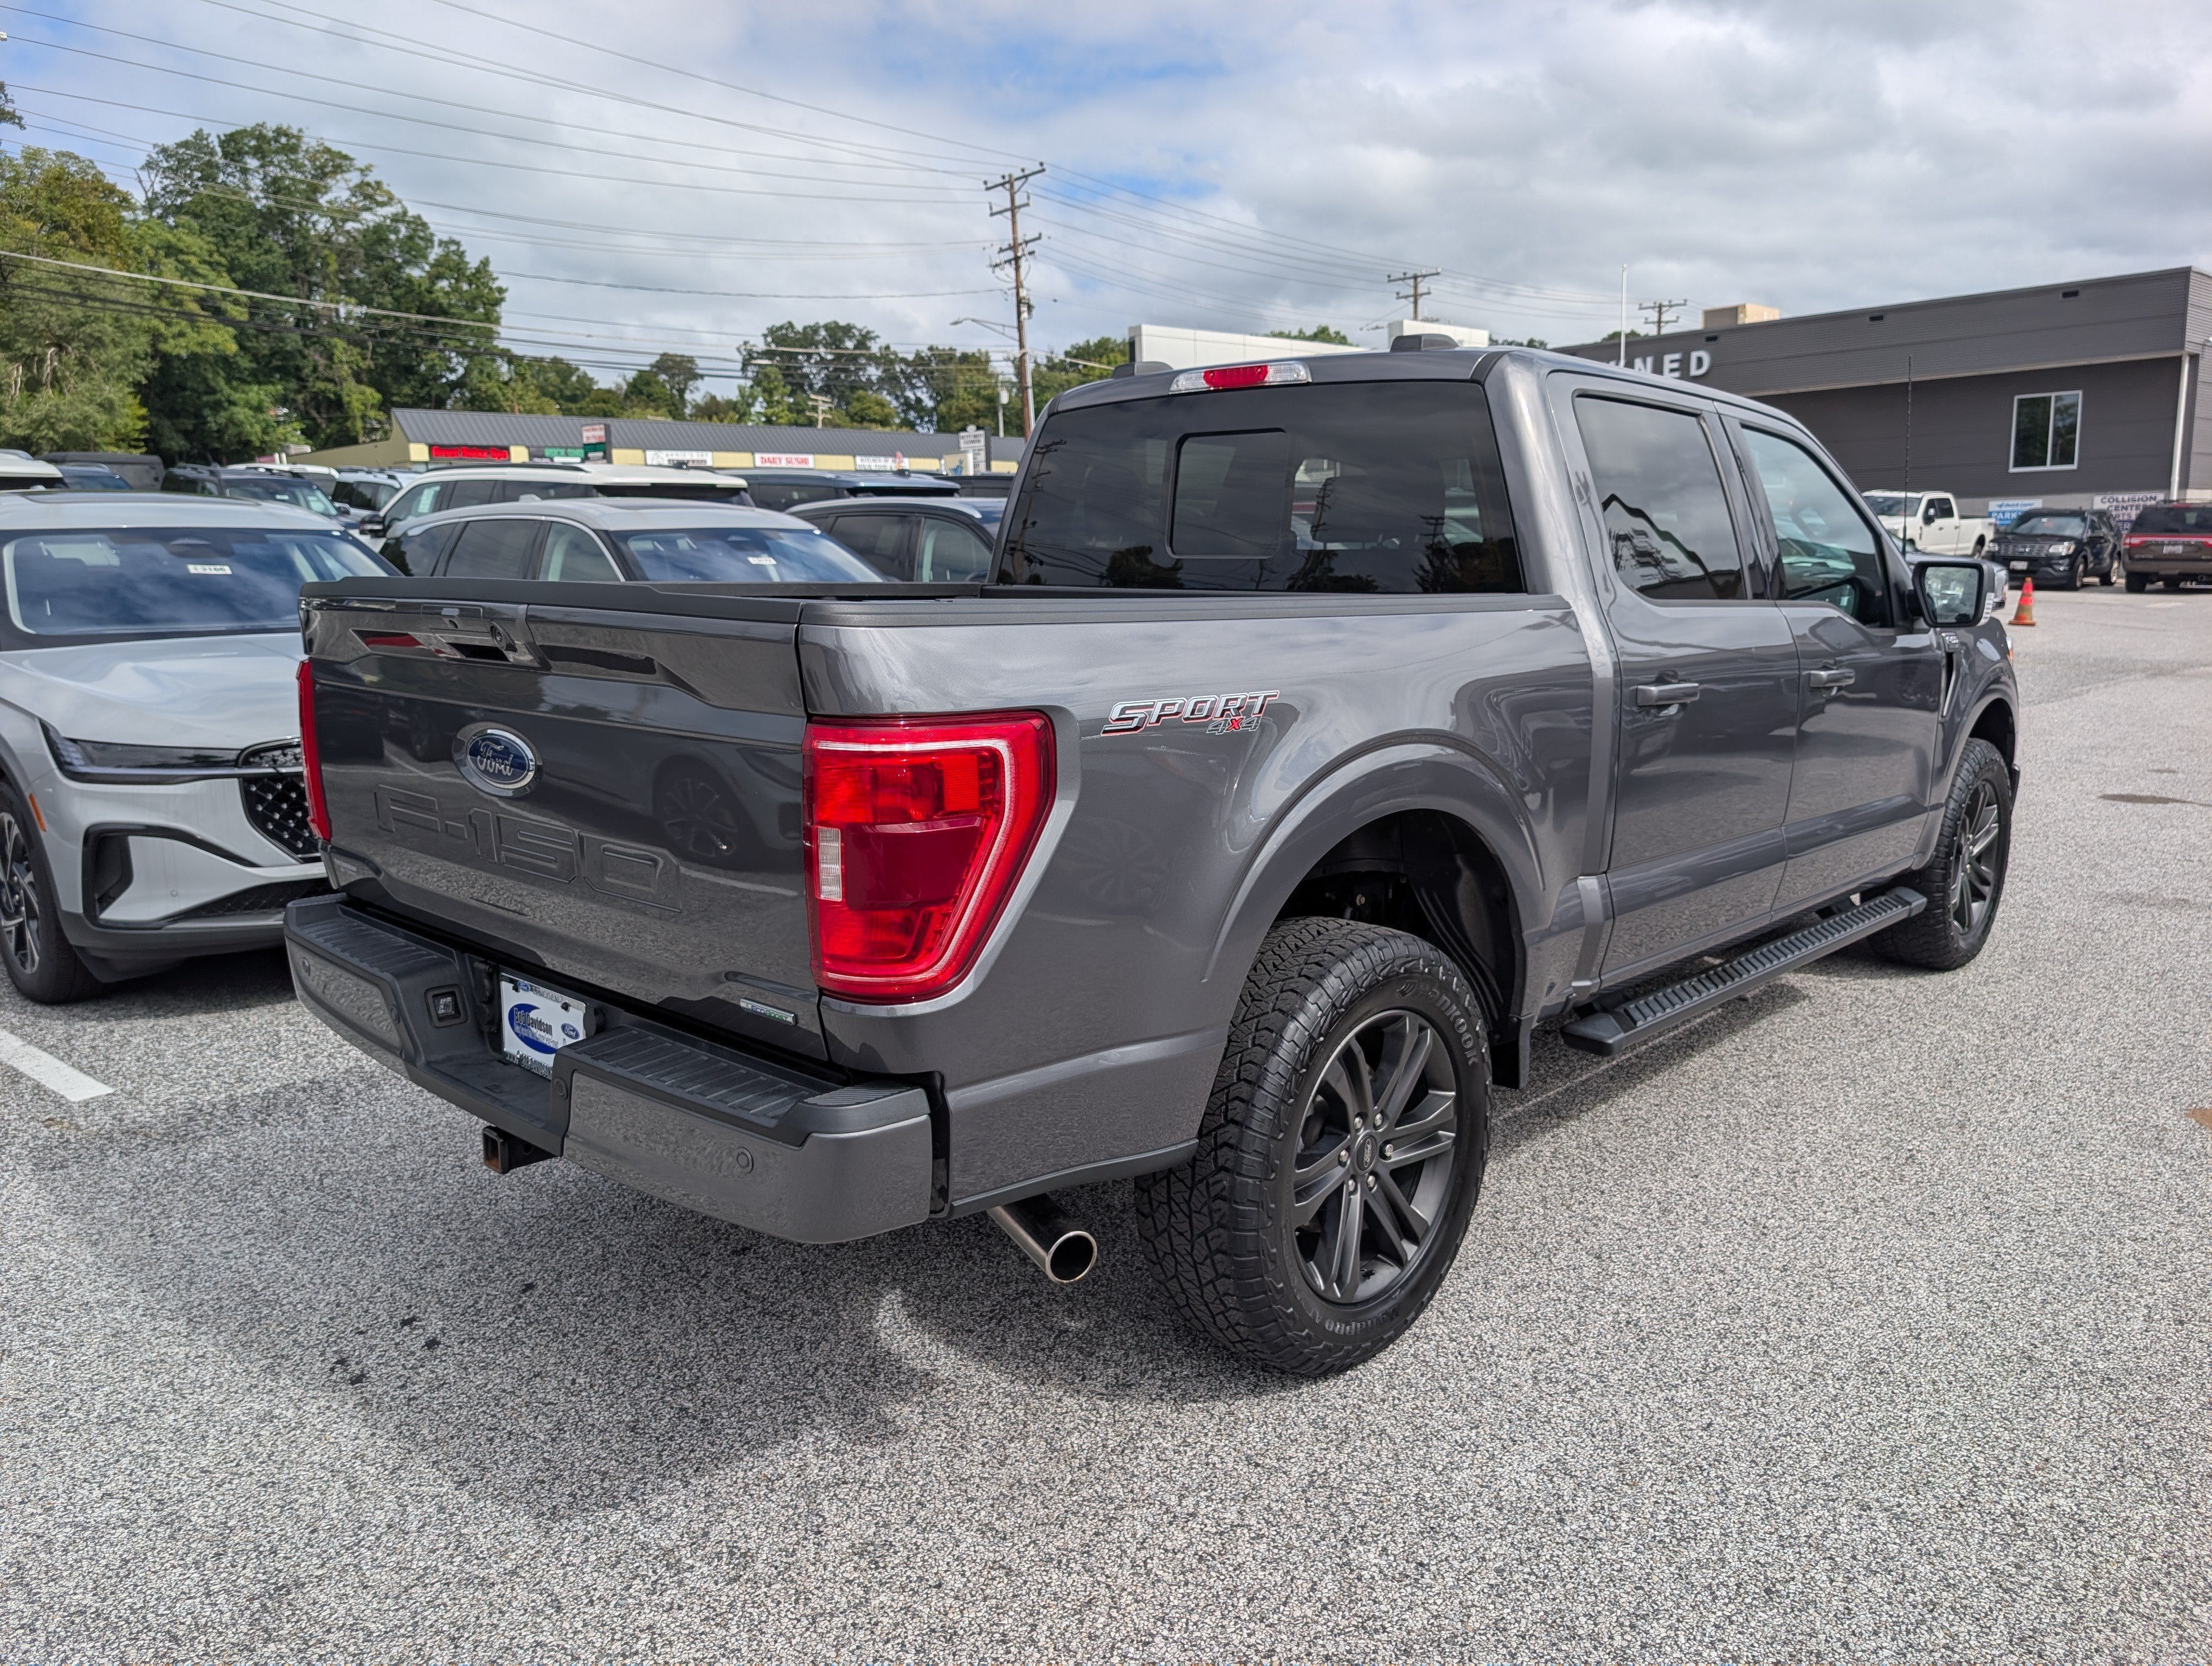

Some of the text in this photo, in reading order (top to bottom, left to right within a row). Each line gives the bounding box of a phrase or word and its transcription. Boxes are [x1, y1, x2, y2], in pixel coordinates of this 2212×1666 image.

[2101, 495, 2157, 504] COLLISION
[2107, 503, 2143, 511] CENTE
[1101, 690, 1280, 736] SPORT
[477, 740, 514, 777] Ford
[374, 784, 682, 913] F-150
[514, 1008, 526, 1024] Bob
[526, 1011, 553, 1036] Davidson
[563, 1024, 577, 1038] Ford
